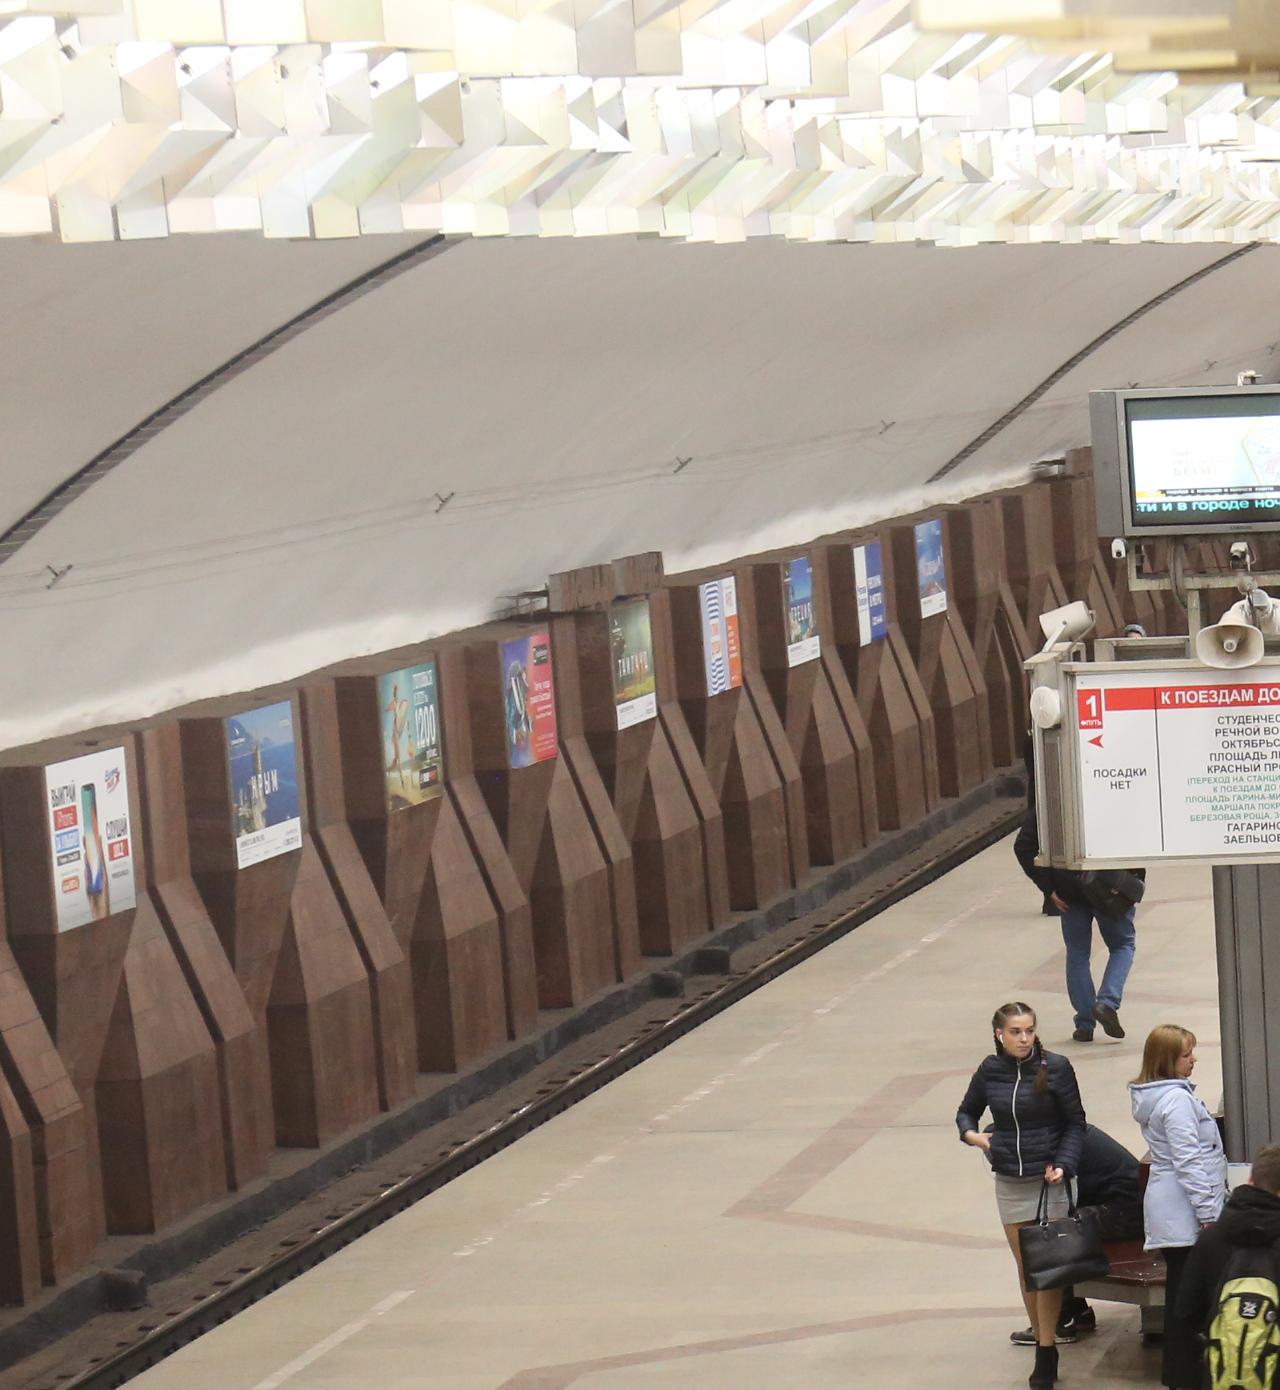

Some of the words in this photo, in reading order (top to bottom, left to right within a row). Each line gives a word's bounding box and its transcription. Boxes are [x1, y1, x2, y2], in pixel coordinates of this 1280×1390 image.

[1162, 502, 1172, 512] и
[1177, 502, 1188, 511] в
[1192, 499, 1249, 513] городе
[1161, 691, 1171, 705] К
[1175, 688, 1254, 705] ПОЕЗДАМ
[1085, 695, 1097, 718] 1
[415, 704, 437, 748] 1200
[1214, 725, 1260, 737] РЕЧНОЙ
[1209, 751, 1268, 763] ПЛОЩАДЬ
[1093, 767, 1147, 778] ПОСАДКИ
[1207, 762, 1261, 774] КРАСНЫЙ
[1109, 780, 1132, 790] НЕТ
[1232, 776, 1245, 784] НА
[1220, 785, 1262, 793] ПОЕЗДАМ
[1264, 784, 1277, 792] ДО
[1185, 794, 1231, 803] ПЛОЩАДЬ
[1211, 804, 1256, 812] МАРШАЛА
[1190, 813, 1242, 822] БЕРЕЗОВАЯ
